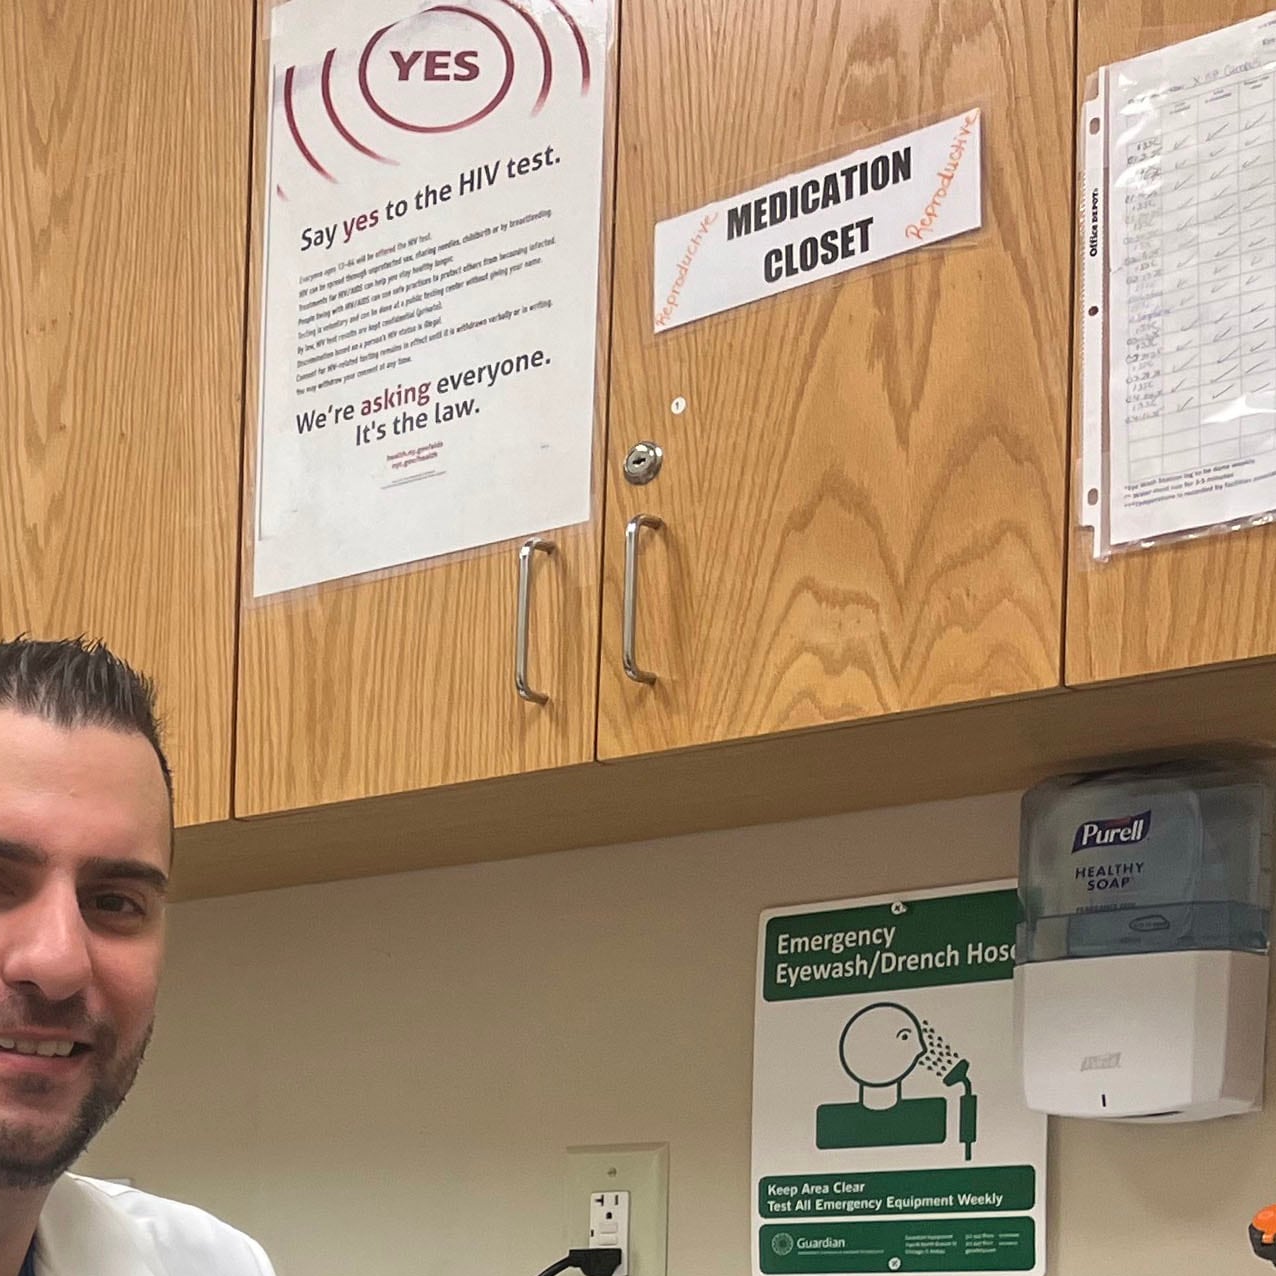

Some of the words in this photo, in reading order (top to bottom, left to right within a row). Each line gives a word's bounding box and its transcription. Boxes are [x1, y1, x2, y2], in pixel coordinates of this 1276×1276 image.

[389, 50, 480, 81] YES
[727, 146, 912, 241] MEDICATION
[905, 114, 977, 241] Reproductive
[300, 224, 337, 251] Say
[342, 209, 379, 243] yes
[385, 200, 408, 220] to
[414, 184, 452, 211] the
[458, 161, 500, 196] HIV
[506, 144, 562, 179] test.
[764, 216, 874, 283] CLOSET
[1089, 225, 1099, 258] Office
[655, 211, 718, 327] Reproductive
[296, 402, 355, 435] We're
[360, 380, 431, 419] asking
[436, 350, 552, 394] everyone.
[355, 422, 387, 446] It's
[392, 410, 428, 435] the
[434, 398, 480, 425] law.
[1081, 819, 1143, 846] Purell
[1075, 861, 1145, 879] HEALTHY
[1087, 877, 1131, 892] SOAP
[777, 925, 896, 956] Emergency
[776, 944, 959, 988] Eyewash/Drench
[767, 1183, 798, 1198] Keep
[801, 1183, 830, 1195] Area
[833, 1182, 865, 1194] Clear
[767, 1200, 792, 1213] Test
[795, 1199, 811, 1211] All
[815, 1197, 882, 1213] Emergency
[886, 1194, 953, 1210] Equipment
[957, 1193, 1003, 1208] Weekly
[797, 1236, 846, 1250] Guardian
